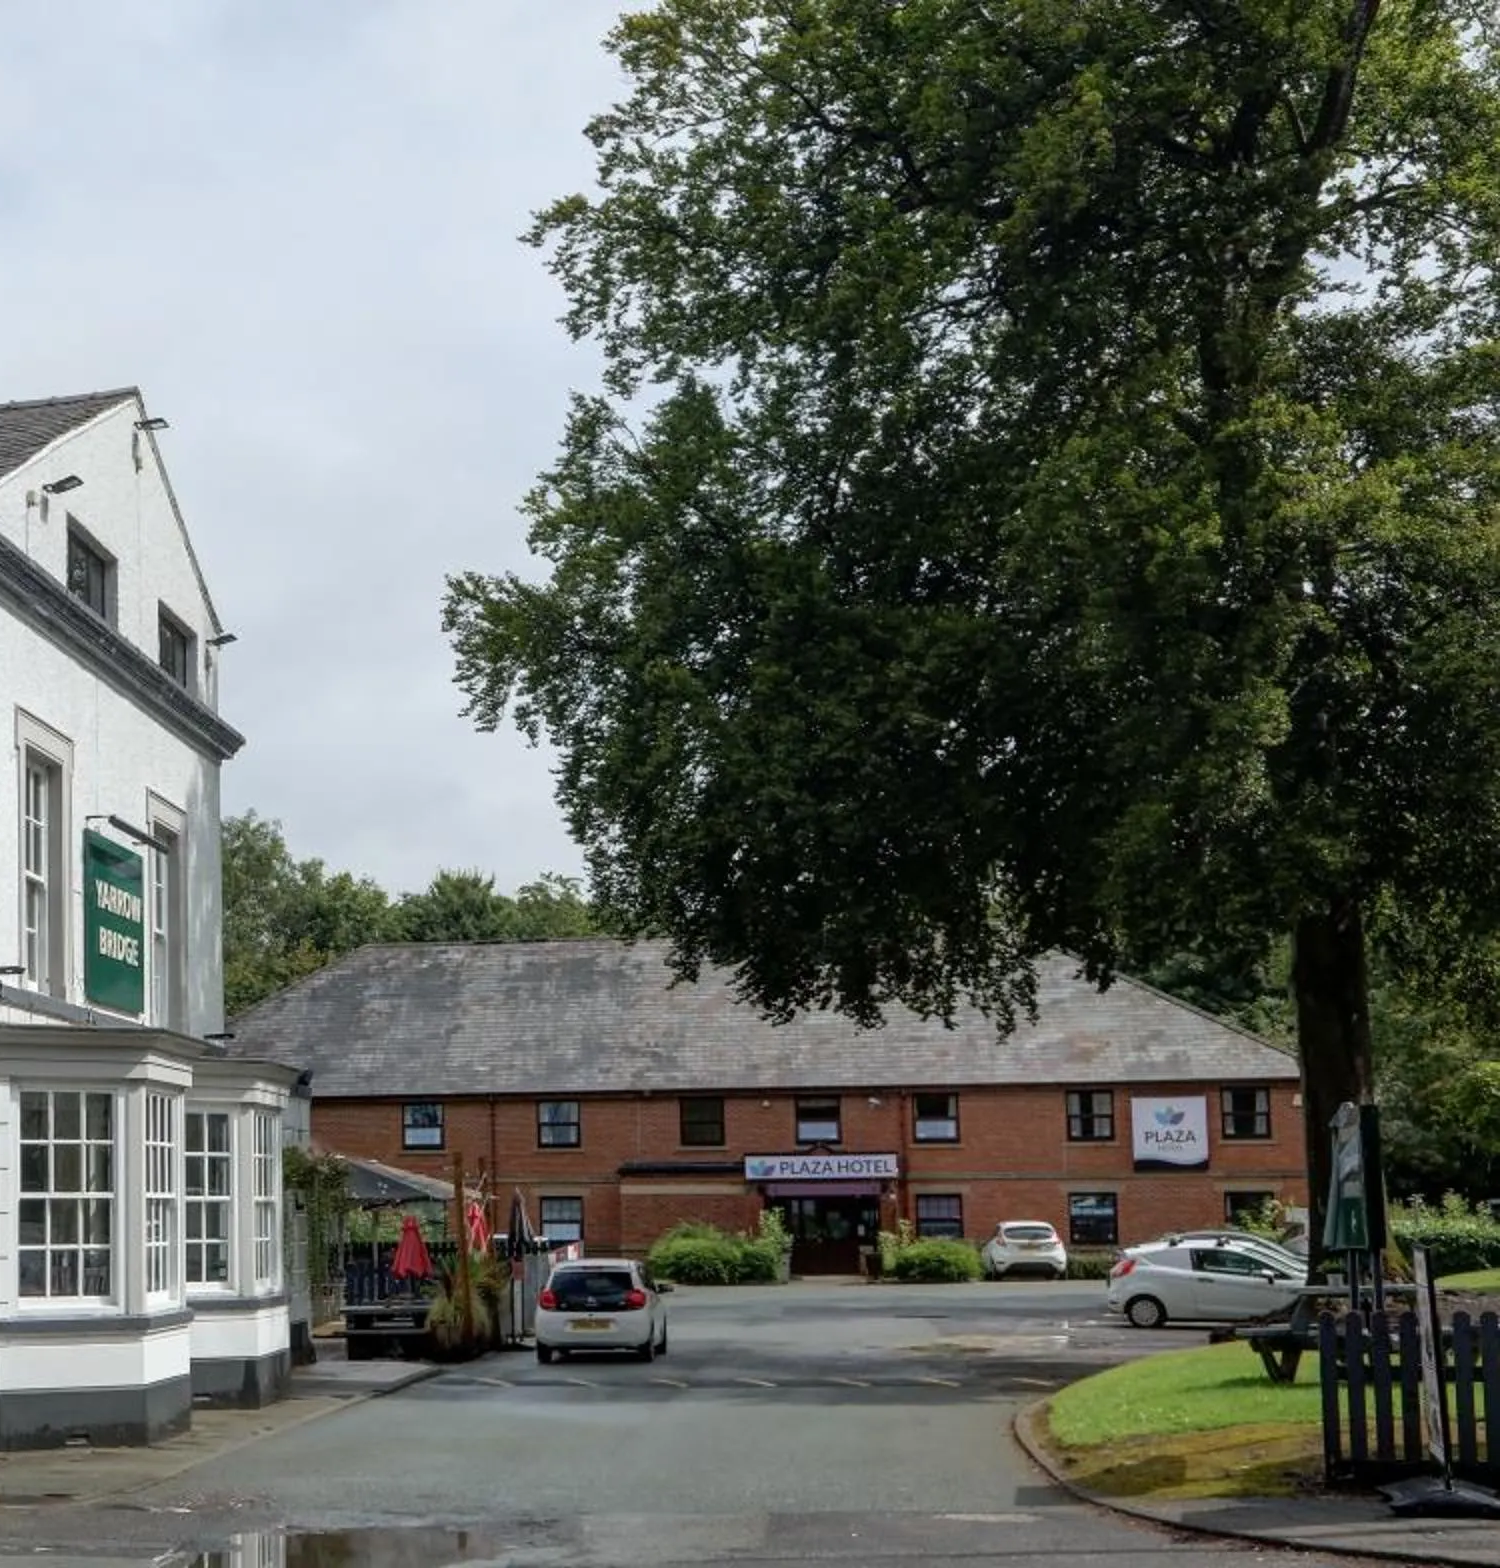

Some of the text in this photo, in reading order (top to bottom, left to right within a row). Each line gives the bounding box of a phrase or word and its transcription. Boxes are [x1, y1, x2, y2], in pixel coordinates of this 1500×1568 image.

[95, 879, 141, 923] YARROW
[100, 926, 139, 967] BRIDGE
[1144, 1130, 1197, 1144] PLAZA
[779, 1159, 893, 1175] PLAZA HOTEL
